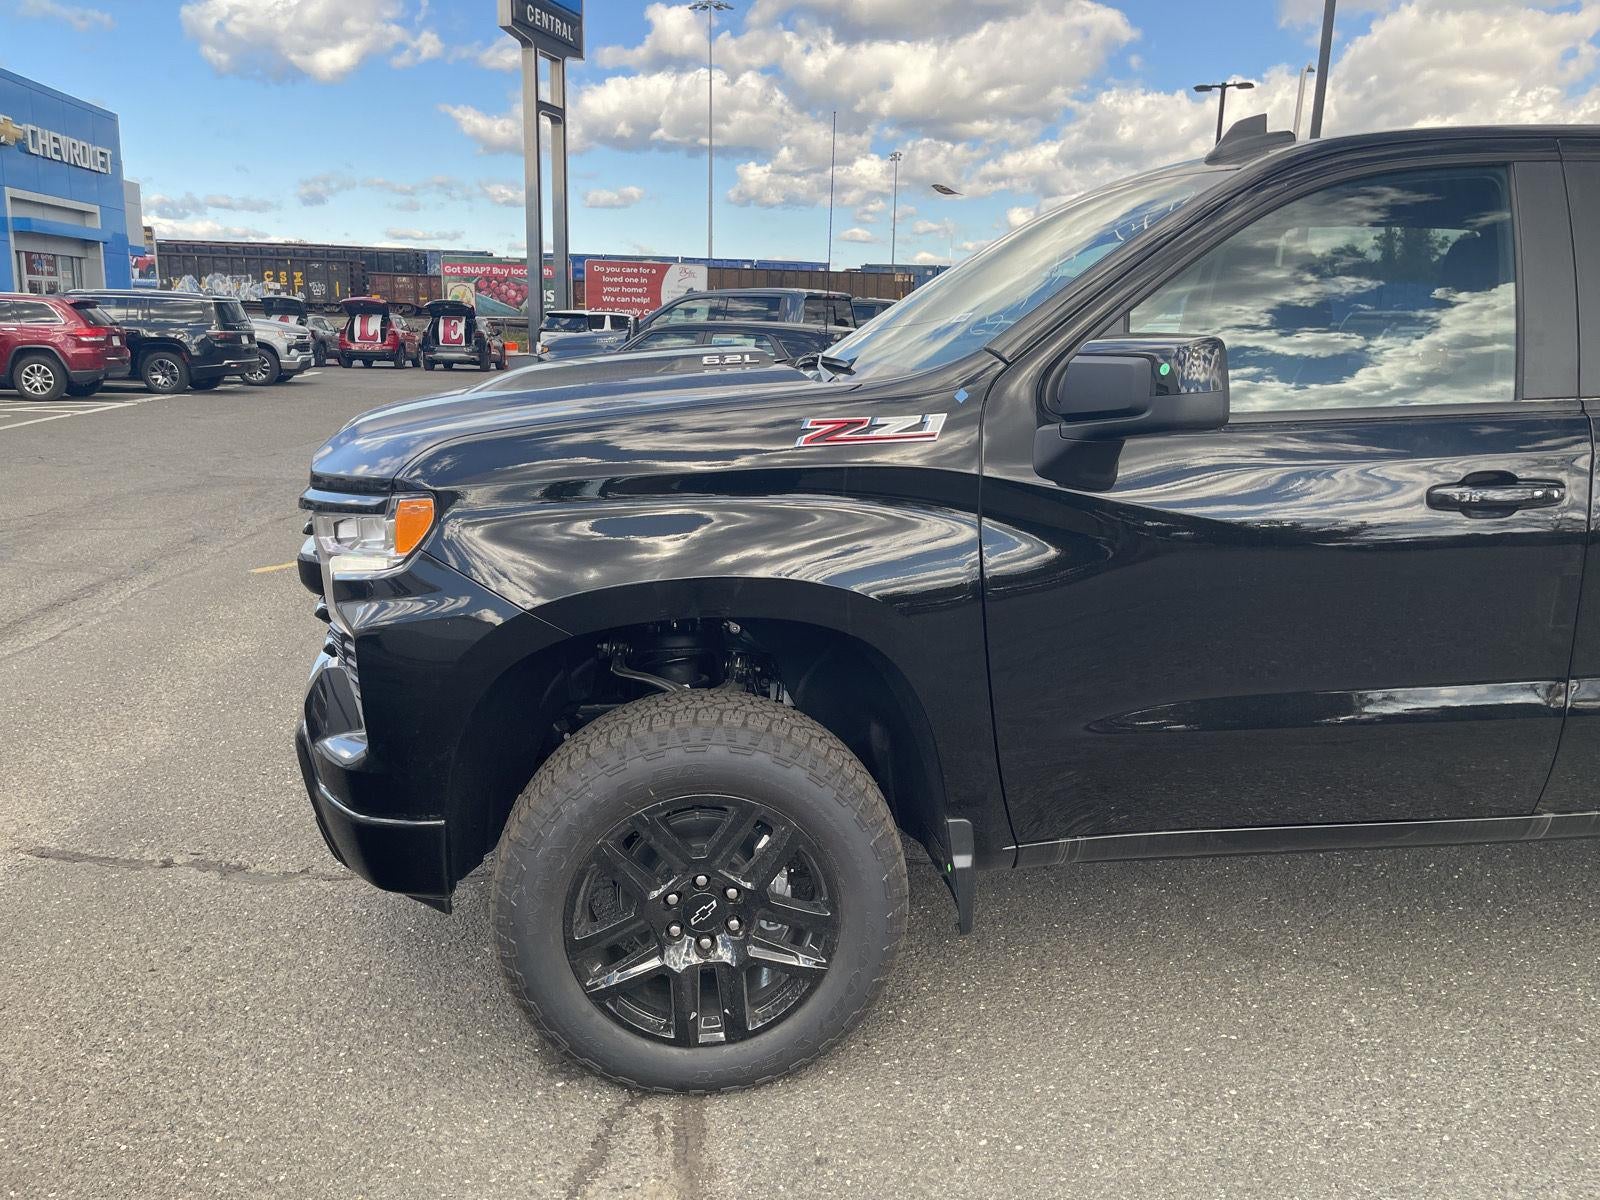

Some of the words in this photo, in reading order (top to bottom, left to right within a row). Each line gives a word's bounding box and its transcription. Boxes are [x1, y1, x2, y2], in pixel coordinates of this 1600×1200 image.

[526, 4, 574, 42] CENTRAL
[26, 124, 112, 175] CHEVROLET
[264, 270, 304, 285] CSX
[444, 265, 461, 273] Got
[462, 266, 491, 274] SNAP?
[492, 267, 510, 277] Buy
[511, 267, 528, 275] loc
[640, 276, 648, 284] in
[631, 296, 651, 304] help!
[358, 314, 379, 342] L
[441, 316, 463, 345] E
[702, 354, 760, 366] 6.2L
[794, 412, 948, 448] Z71
